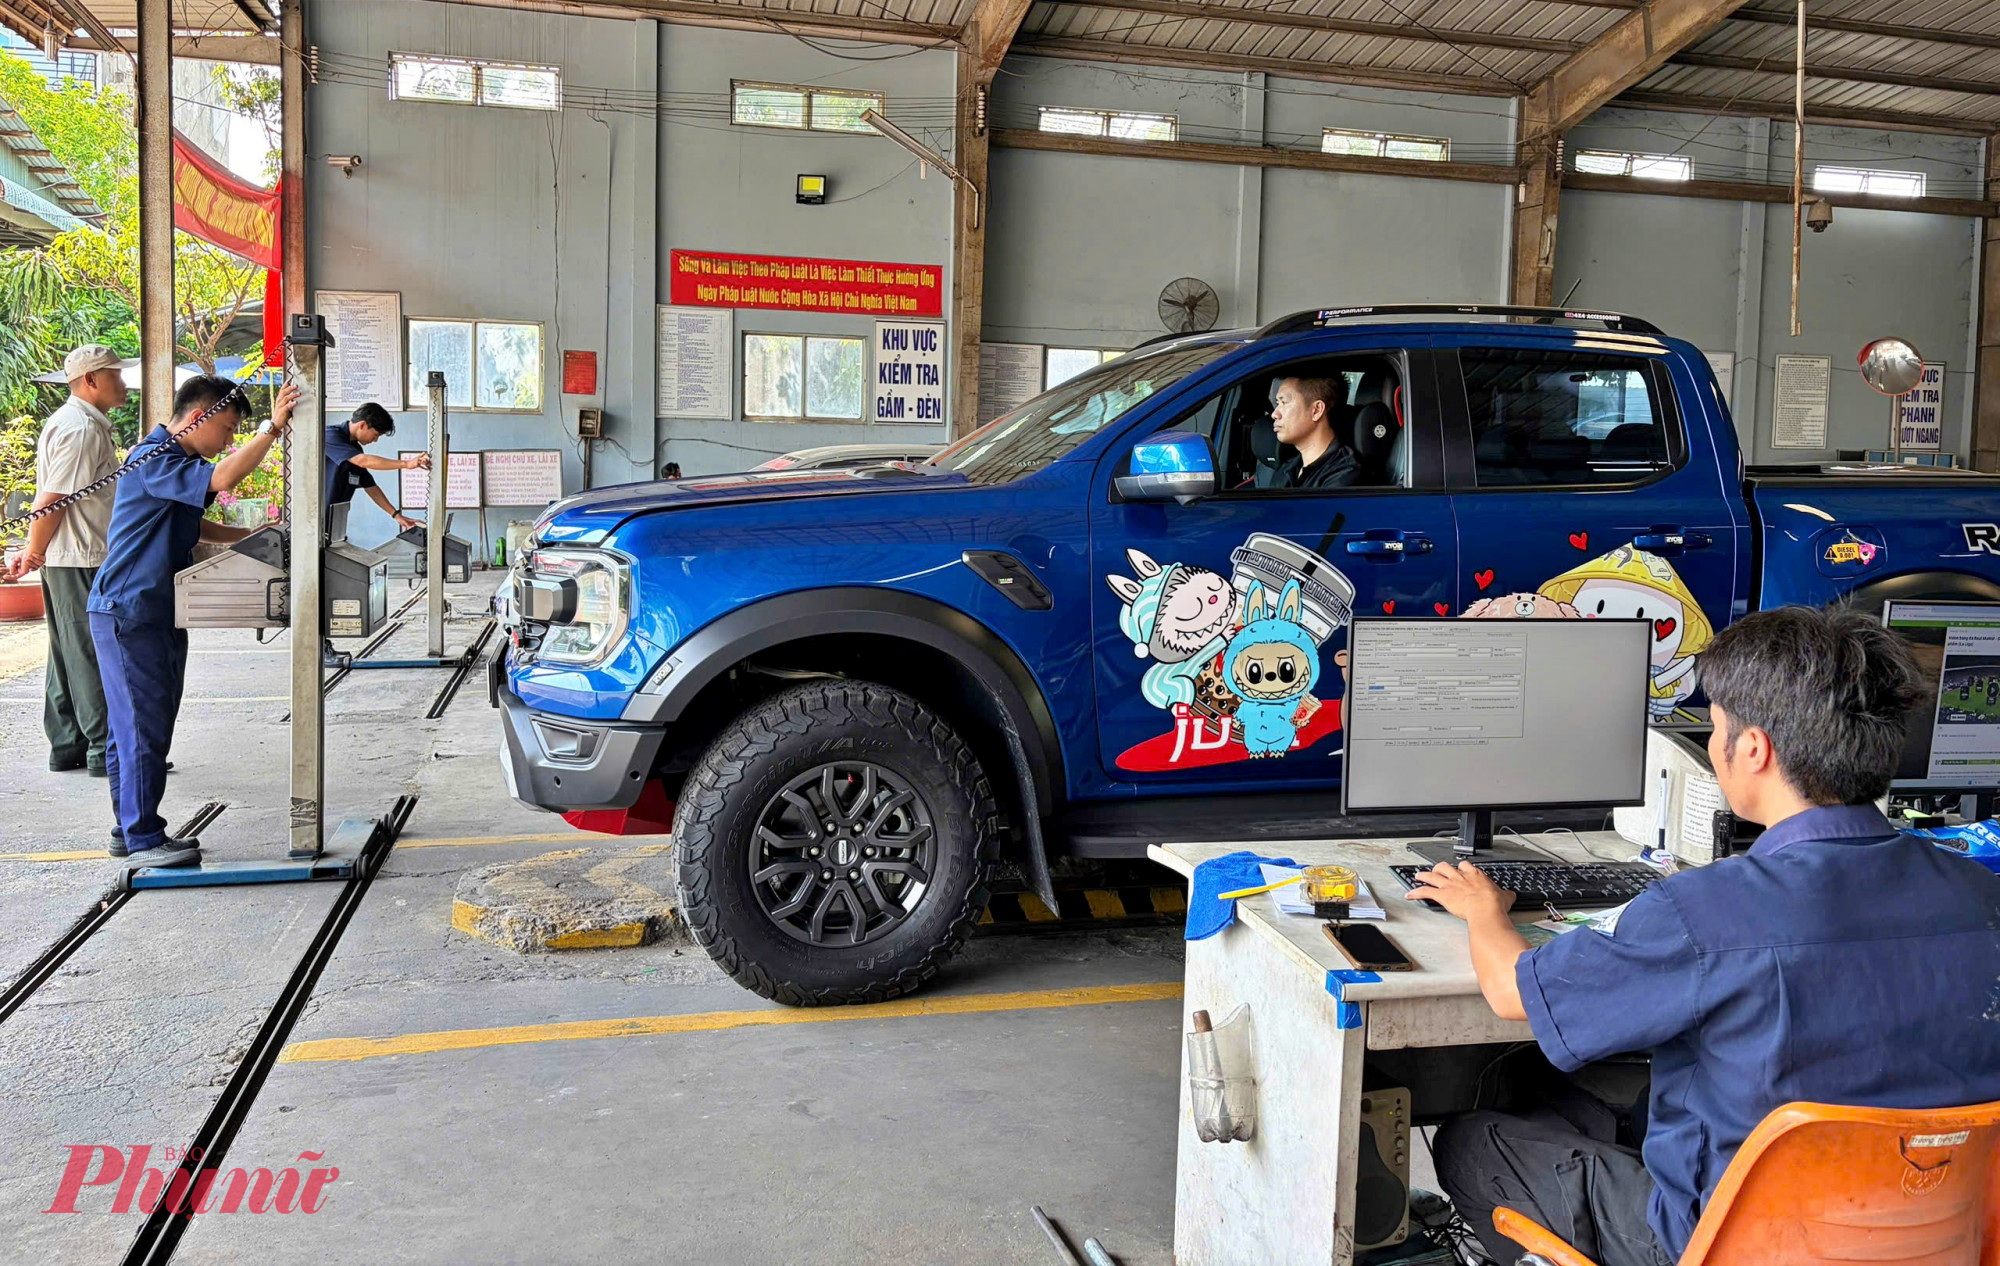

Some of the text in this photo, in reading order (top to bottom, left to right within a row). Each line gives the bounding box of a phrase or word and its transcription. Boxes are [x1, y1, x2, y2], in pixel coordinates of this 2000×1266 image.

[680, 255, 935, 288] Sống Và Làm Việc Theo Pháp Luật Là Việc Làm Thiết Thực Hưởng Ứng
[697, 284, 917, 313] Ngày Pháp Luật Nước Cộng Hòa Xã Hội Chủ Nghĩa Việt Nam
[882, 328, 937, 356] KHU VỰC
[879, 354, 939, 385] KIỂM TRA
[877, 389, 905, 418] GẦM
[917, 393, 941, 419] ĐÈN
[1922, 389, 1939, 403] TRA
[1916, 428, 1939, 443] NGANG
[550, 454, 558, 464] XE
[1962, 523, 2000, 555] R
